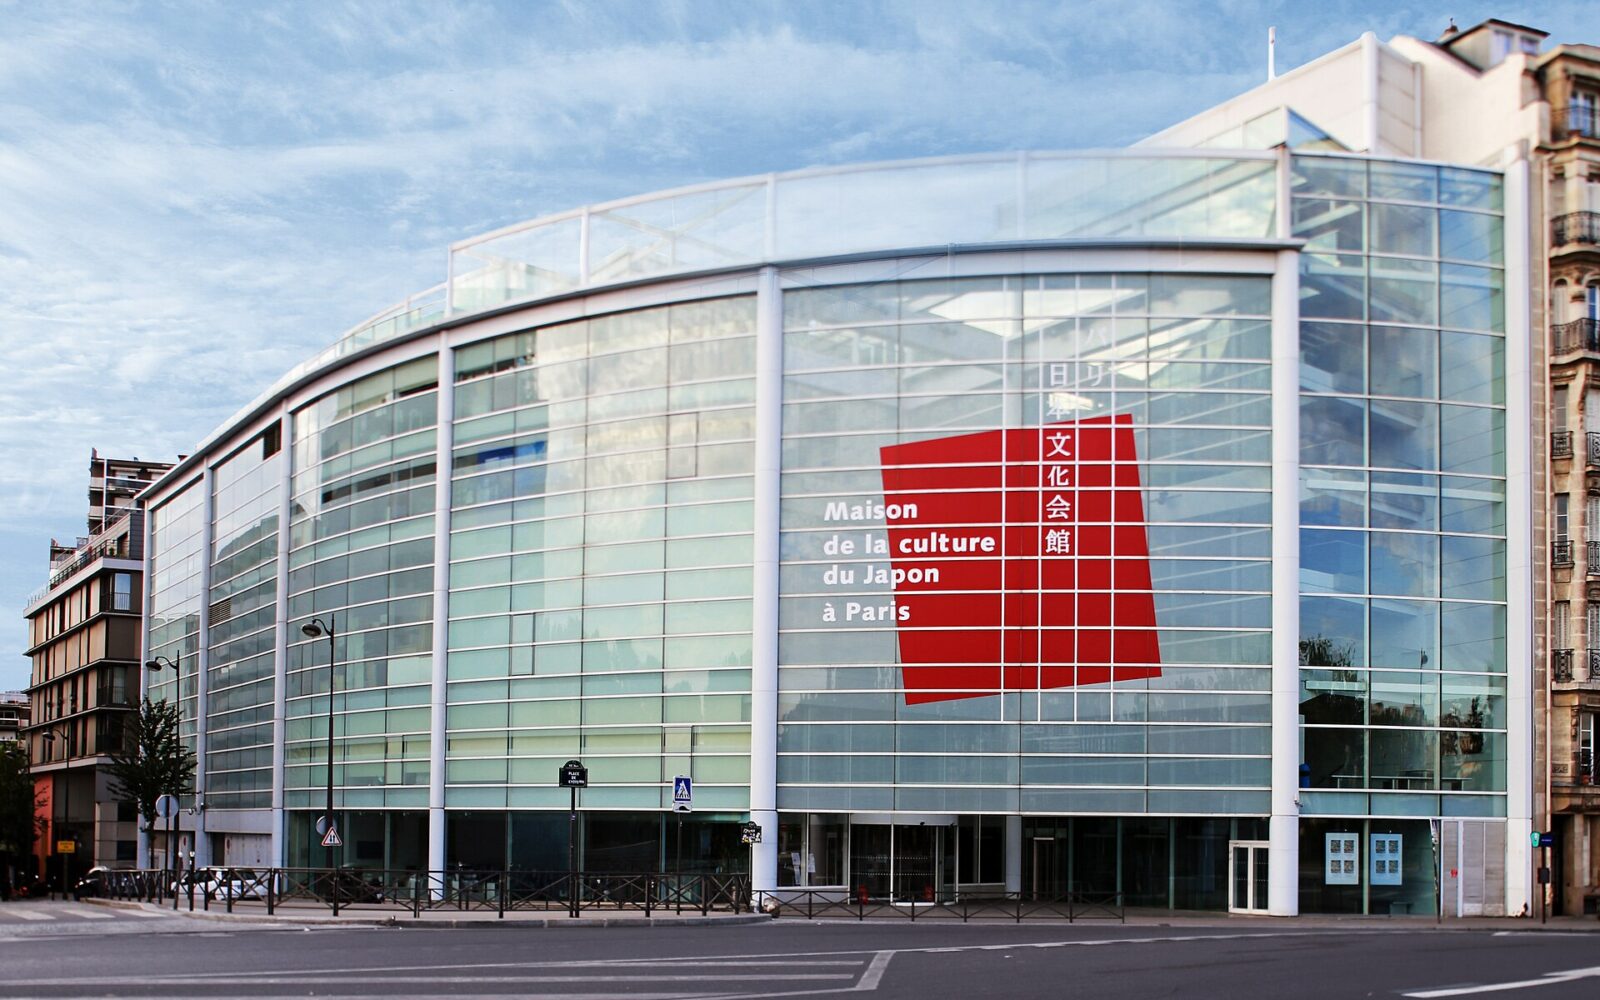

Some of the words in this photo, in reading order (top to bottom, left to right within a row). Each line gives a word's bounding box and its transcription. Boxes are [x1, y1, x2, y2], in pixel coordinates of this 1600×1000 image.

[824, 500, 918, 521] Maison
[823, 535, 855, 555] de
[865, 534, 888, 554] la
[899, 532, 996, 554] culture
[823, 565, 855, 585] du
[863, 565, 940, 590] Japon
[822, 603, 837, 622] à
[846, 600, 911, 621] Paris
